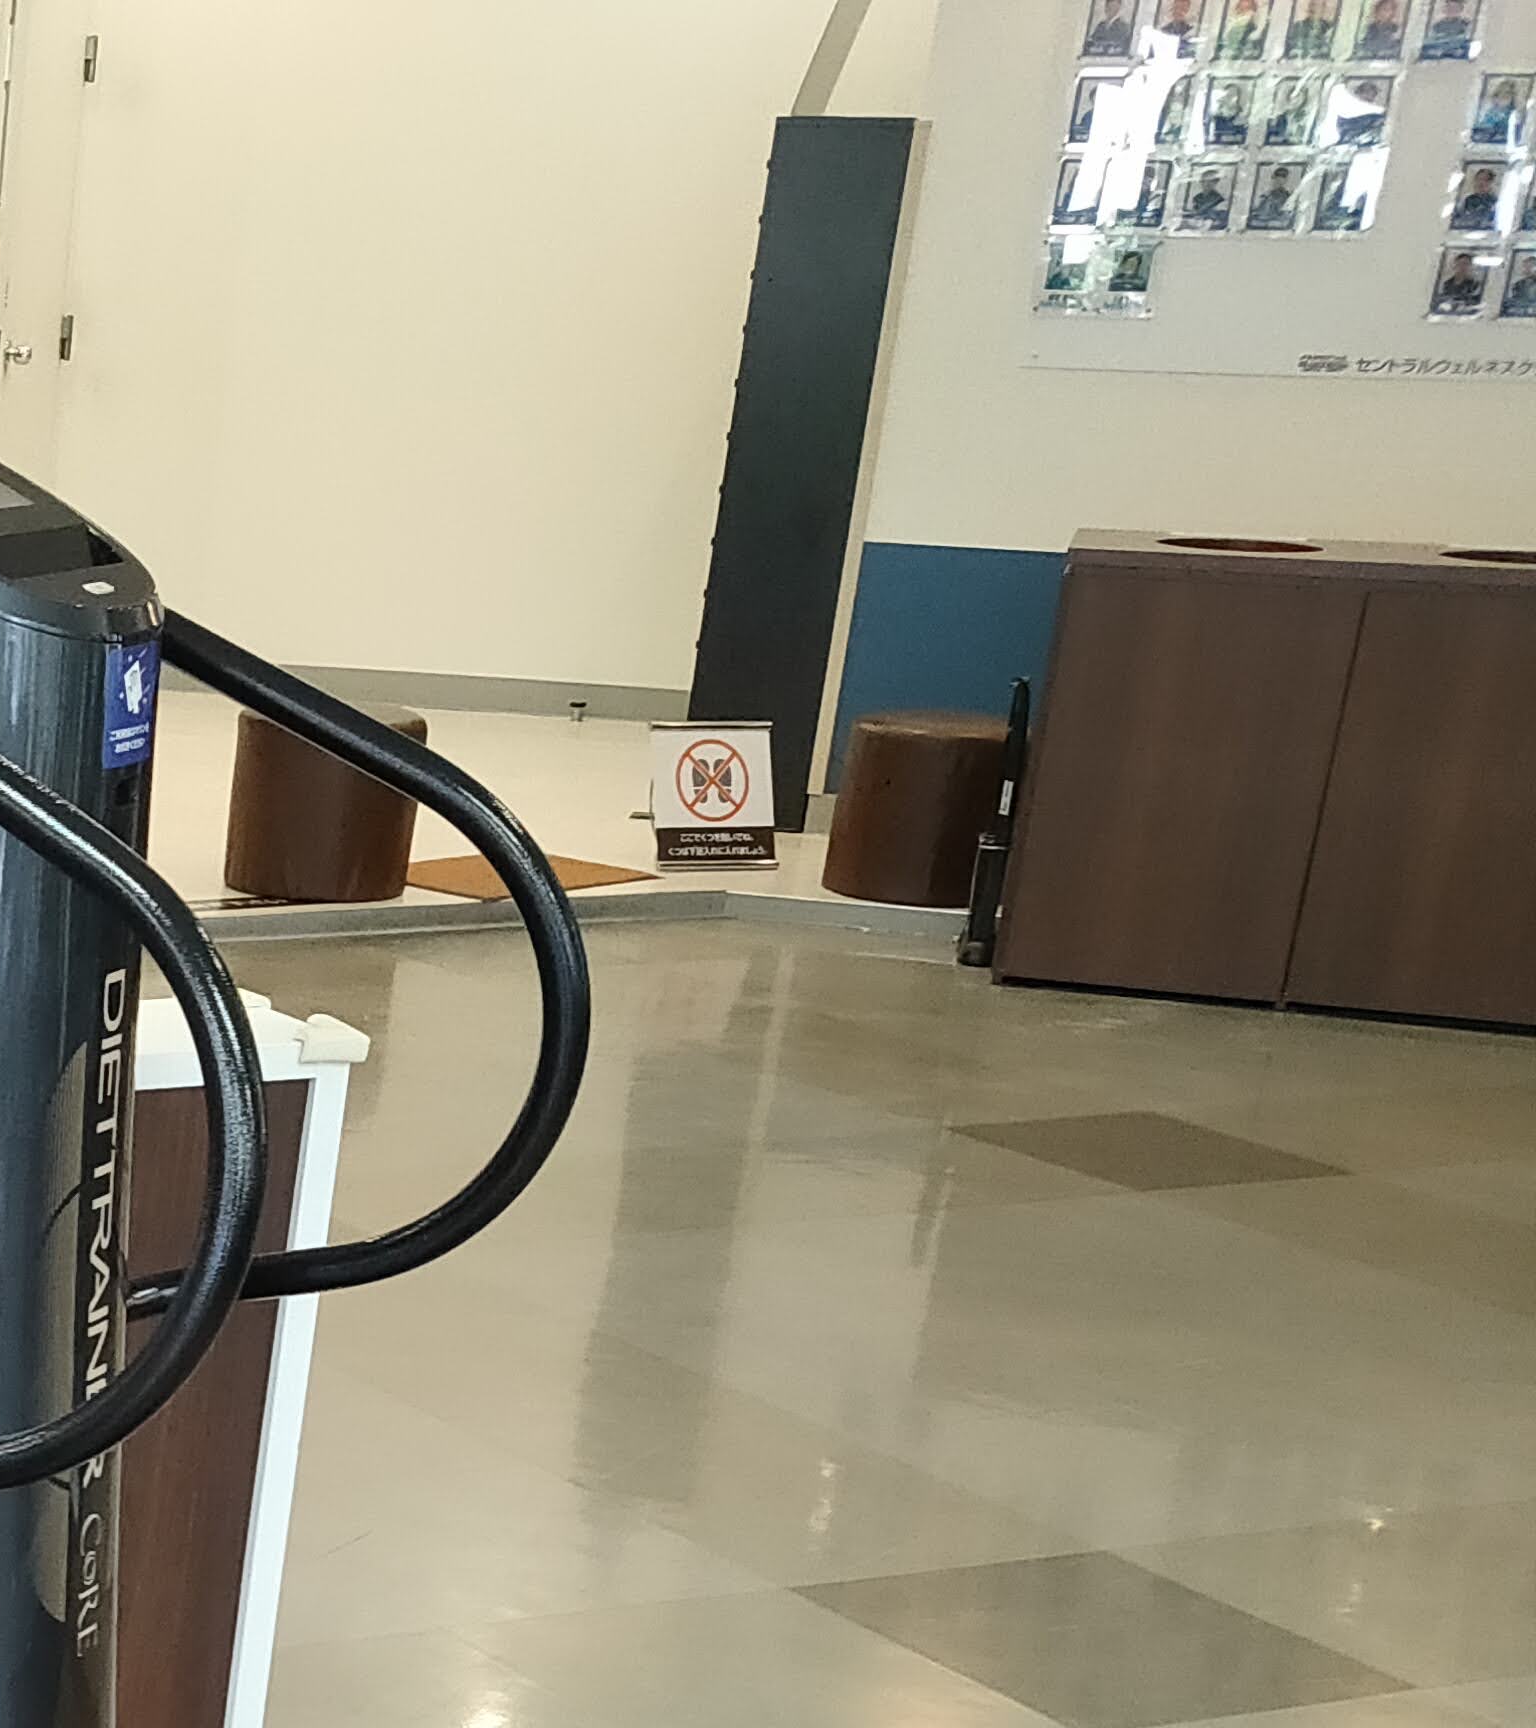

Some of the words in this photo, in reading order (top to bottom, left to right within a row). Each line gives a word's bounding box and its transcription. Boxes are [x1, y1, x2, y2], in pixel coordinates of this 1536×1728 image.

[1356, 357, 1536, 376] セントラルウェルネスク
